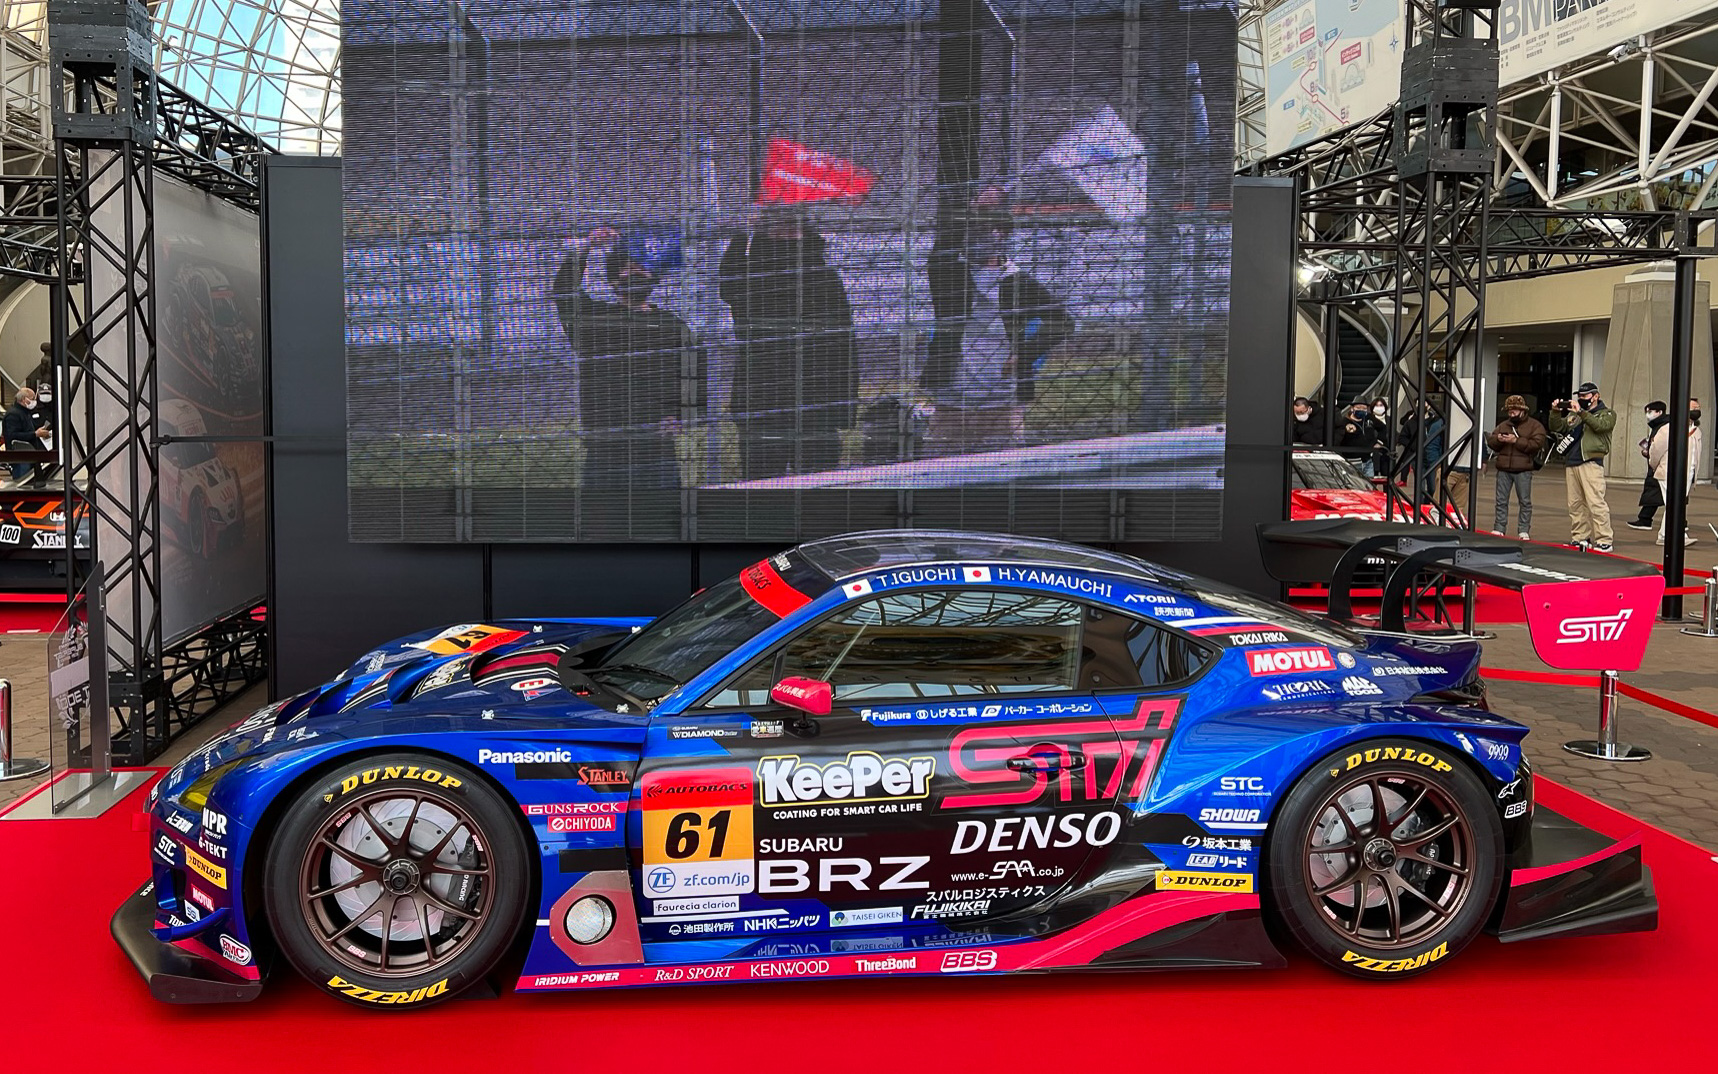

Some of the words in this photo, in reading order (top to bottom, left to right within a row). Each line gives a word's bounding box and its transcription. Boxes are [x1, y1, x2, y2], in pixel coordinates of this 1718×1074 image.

[1556, 433, 1575, 454] CHUMS
[2, 526, 19, 542] 100
[876, 568, 957, 587] T.IGUCHI
[998, 567, 1113, 598] H.YAMAUCHI
[1229, 633, 1263, 646] TOKAI
[1264, 632, 1289, 643] RIKA
[1253, 650, 1332, 673] MOTUL
[872, 712, 911, 723] Fujikura
[478, 748, 572, 764] Panasonic
[1346, 747, 1452, 773] DUNLOP
[341, 766, 462, 795] DUNLOP
[577, 766, 630, 785] STANLEY
[761, 755, 932, 803] KeePer
[1220, 777, 1264, 791] STC
[665, 783, 748, 794] AUTOBACS
[202, 807, 227, 834] NPR
[773, 809, 817, 820] COATING
[821, 808, 841, 818] FOR
[843, 805, 876, 816] SMART
[879, 804, 898, 814] CAR
[900, 803, 922, 813] LIFE
[1198, 808, 1261, 822] SHOWA
[565, 817, 612, 830] CHIYODA
[665, 810, 731, 860] 61
[950, 811, 1121, 855] DENSO
[158, 835, 177, 857] STC
[198, 836, 228, 859] G-TEKT
[759, 837, 843, 853] SUBARU
[1202, 836, 1252, 851] 坂本工業
[191, 856, 222, 881] DUNLOP
[1219, 855, 1248, 868] リード
[651, 872, 675, 888] ZF
[684, 872, 750, 887] zf.com/jp
[758, 855, 931, 894] BRZ
[1174, 876, 1247, 888] DUNLOP
[192, 886, 215, 912] MOTUL
[926, 885, 1046, 903] スバルロジスティクス
[657, 902, 700, 912] faurecia
[702, 900, 737, 910] clarion
[911, 900, 991, 919] FUJIKIKAI
[852, 913, 876, 921] TAISEI
[878, 912, 902, 920] GIKEN
[683, 922, 735, 934] 池田製作所
[855, 956, 916, 972] ThreeBond
[942, 950, 997, 972] BBS
[1341, 941, 1449, 972] DIREZZA
[654, 969, 684, 982] R&D
[686, 966, 734, 980] SPORT
[750, 960, 829, 978] KENWOOD
[534, 976, 578, 987] IRIDIUM
[580, 972, 620, 983] POWER
[327, 975, 450, 1004] DIREZZA
